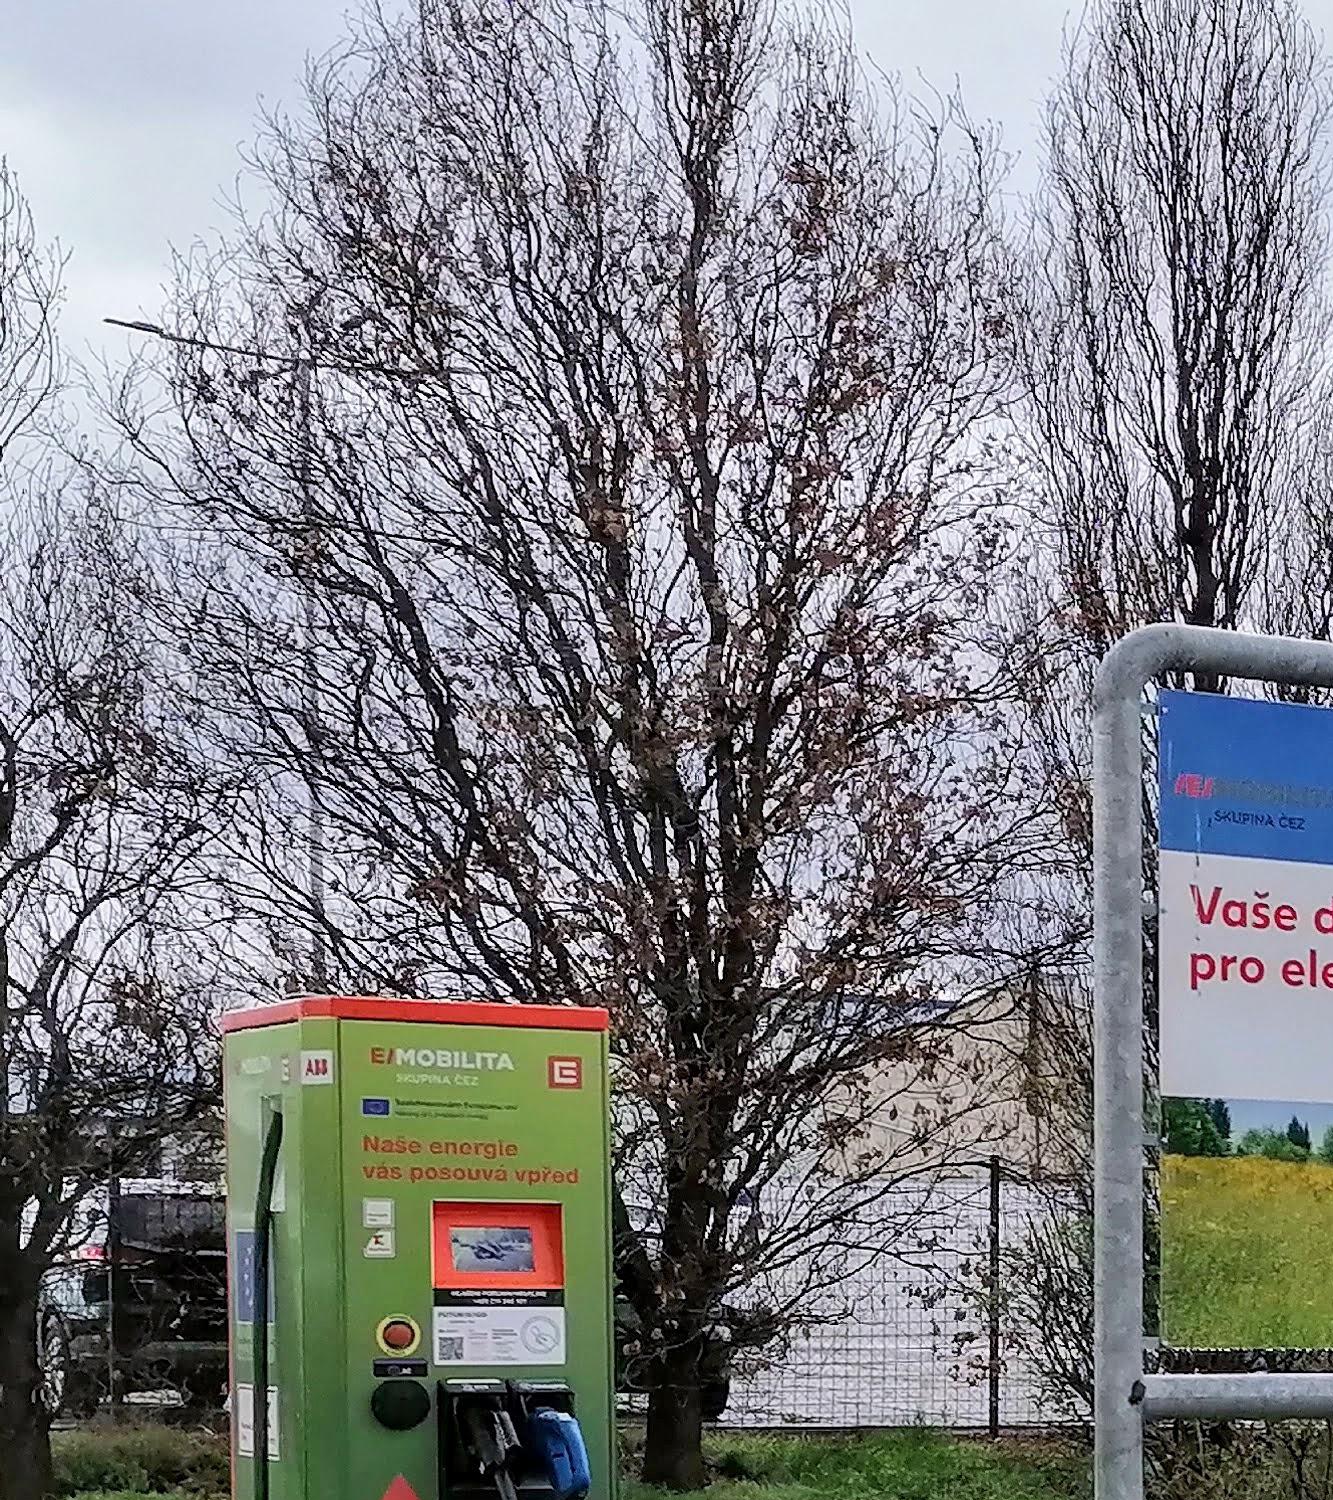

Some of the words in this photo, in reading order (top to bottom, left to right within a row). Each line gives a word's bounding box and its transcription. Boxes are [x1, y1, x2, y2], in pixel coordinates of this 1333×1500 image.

[1278, 812, 1306, 831] ČEZ
[1189, 885, 1298, 931] Vaše
[1189, 951, 1265, 990] pro
[363, 1135, 421, 1154] Naše
[429, 1139, 519, 1160] energie
[363, 1163, 402, 1181] vás
[410, 1164, 508, 1184] posouvá
[515, 1167, 580, 1186] vpřed
